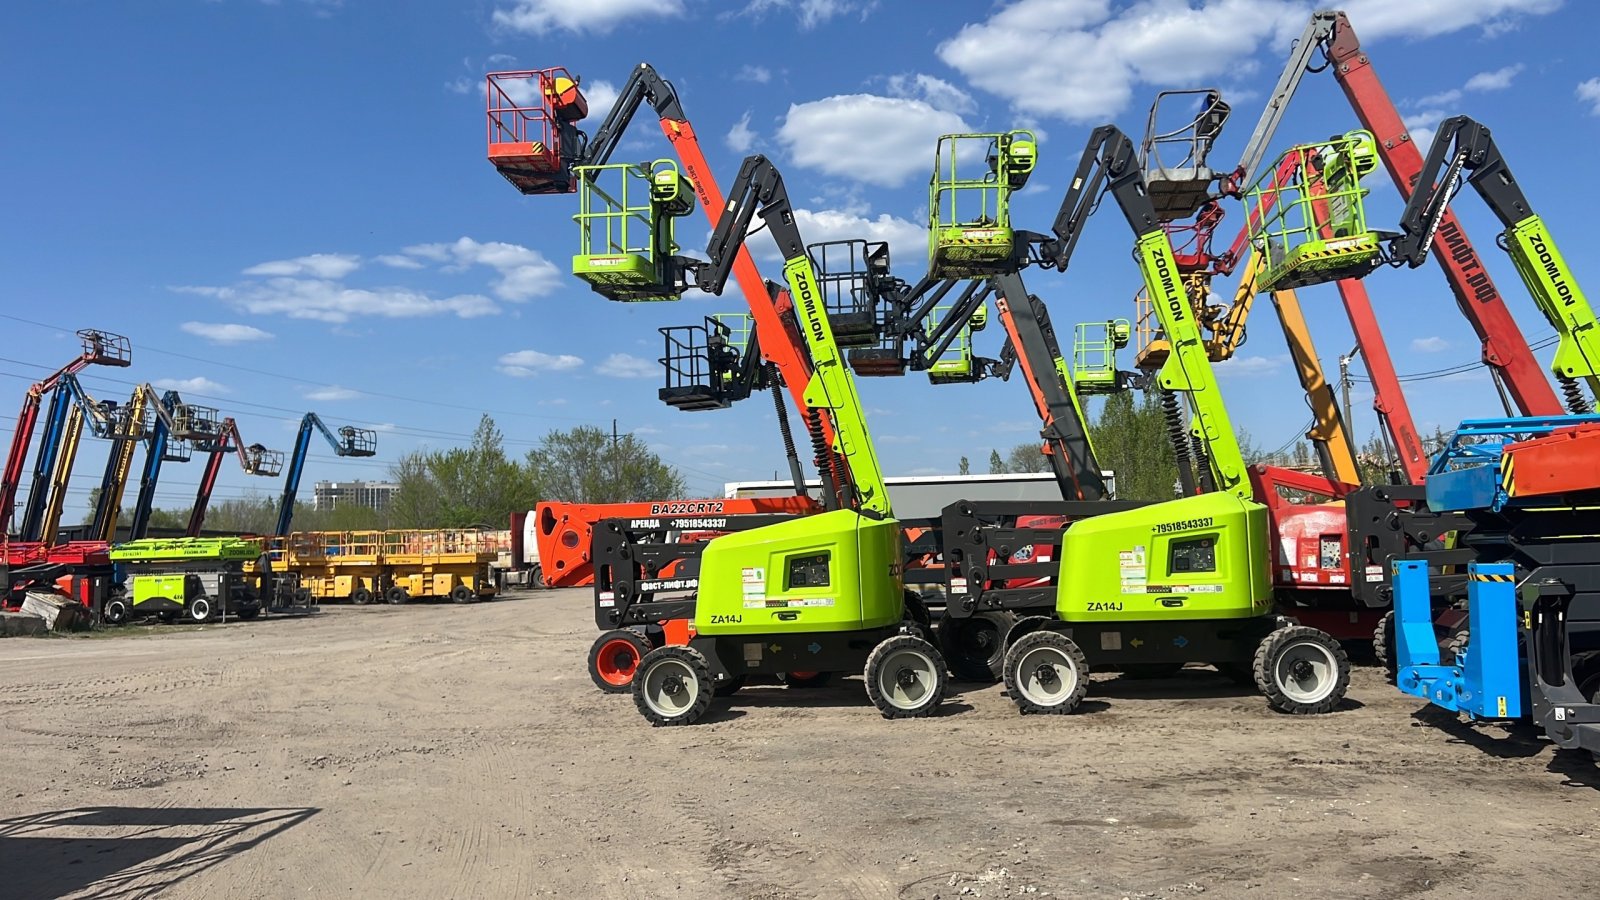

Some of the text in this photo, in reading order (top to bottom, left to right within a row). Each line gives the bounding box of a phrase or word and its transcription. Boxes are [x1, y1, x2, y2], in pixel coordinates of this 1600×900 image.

[1529, 233, 1576, 307] ZOOMLION
[1152, 248, 1185, 322] ZOOMLION
[795, 271, 825, 342] ZOOMLION
[651, 502, 723, 516] BA22CRT2
[630, 518, 727, 529] АРЕНДА +79518543337
[1151, 516, 1213, 533] +79518543337
[1087, 602, 1123, 611] ZA14J
[711, 615, 742, 624] ZA14J
